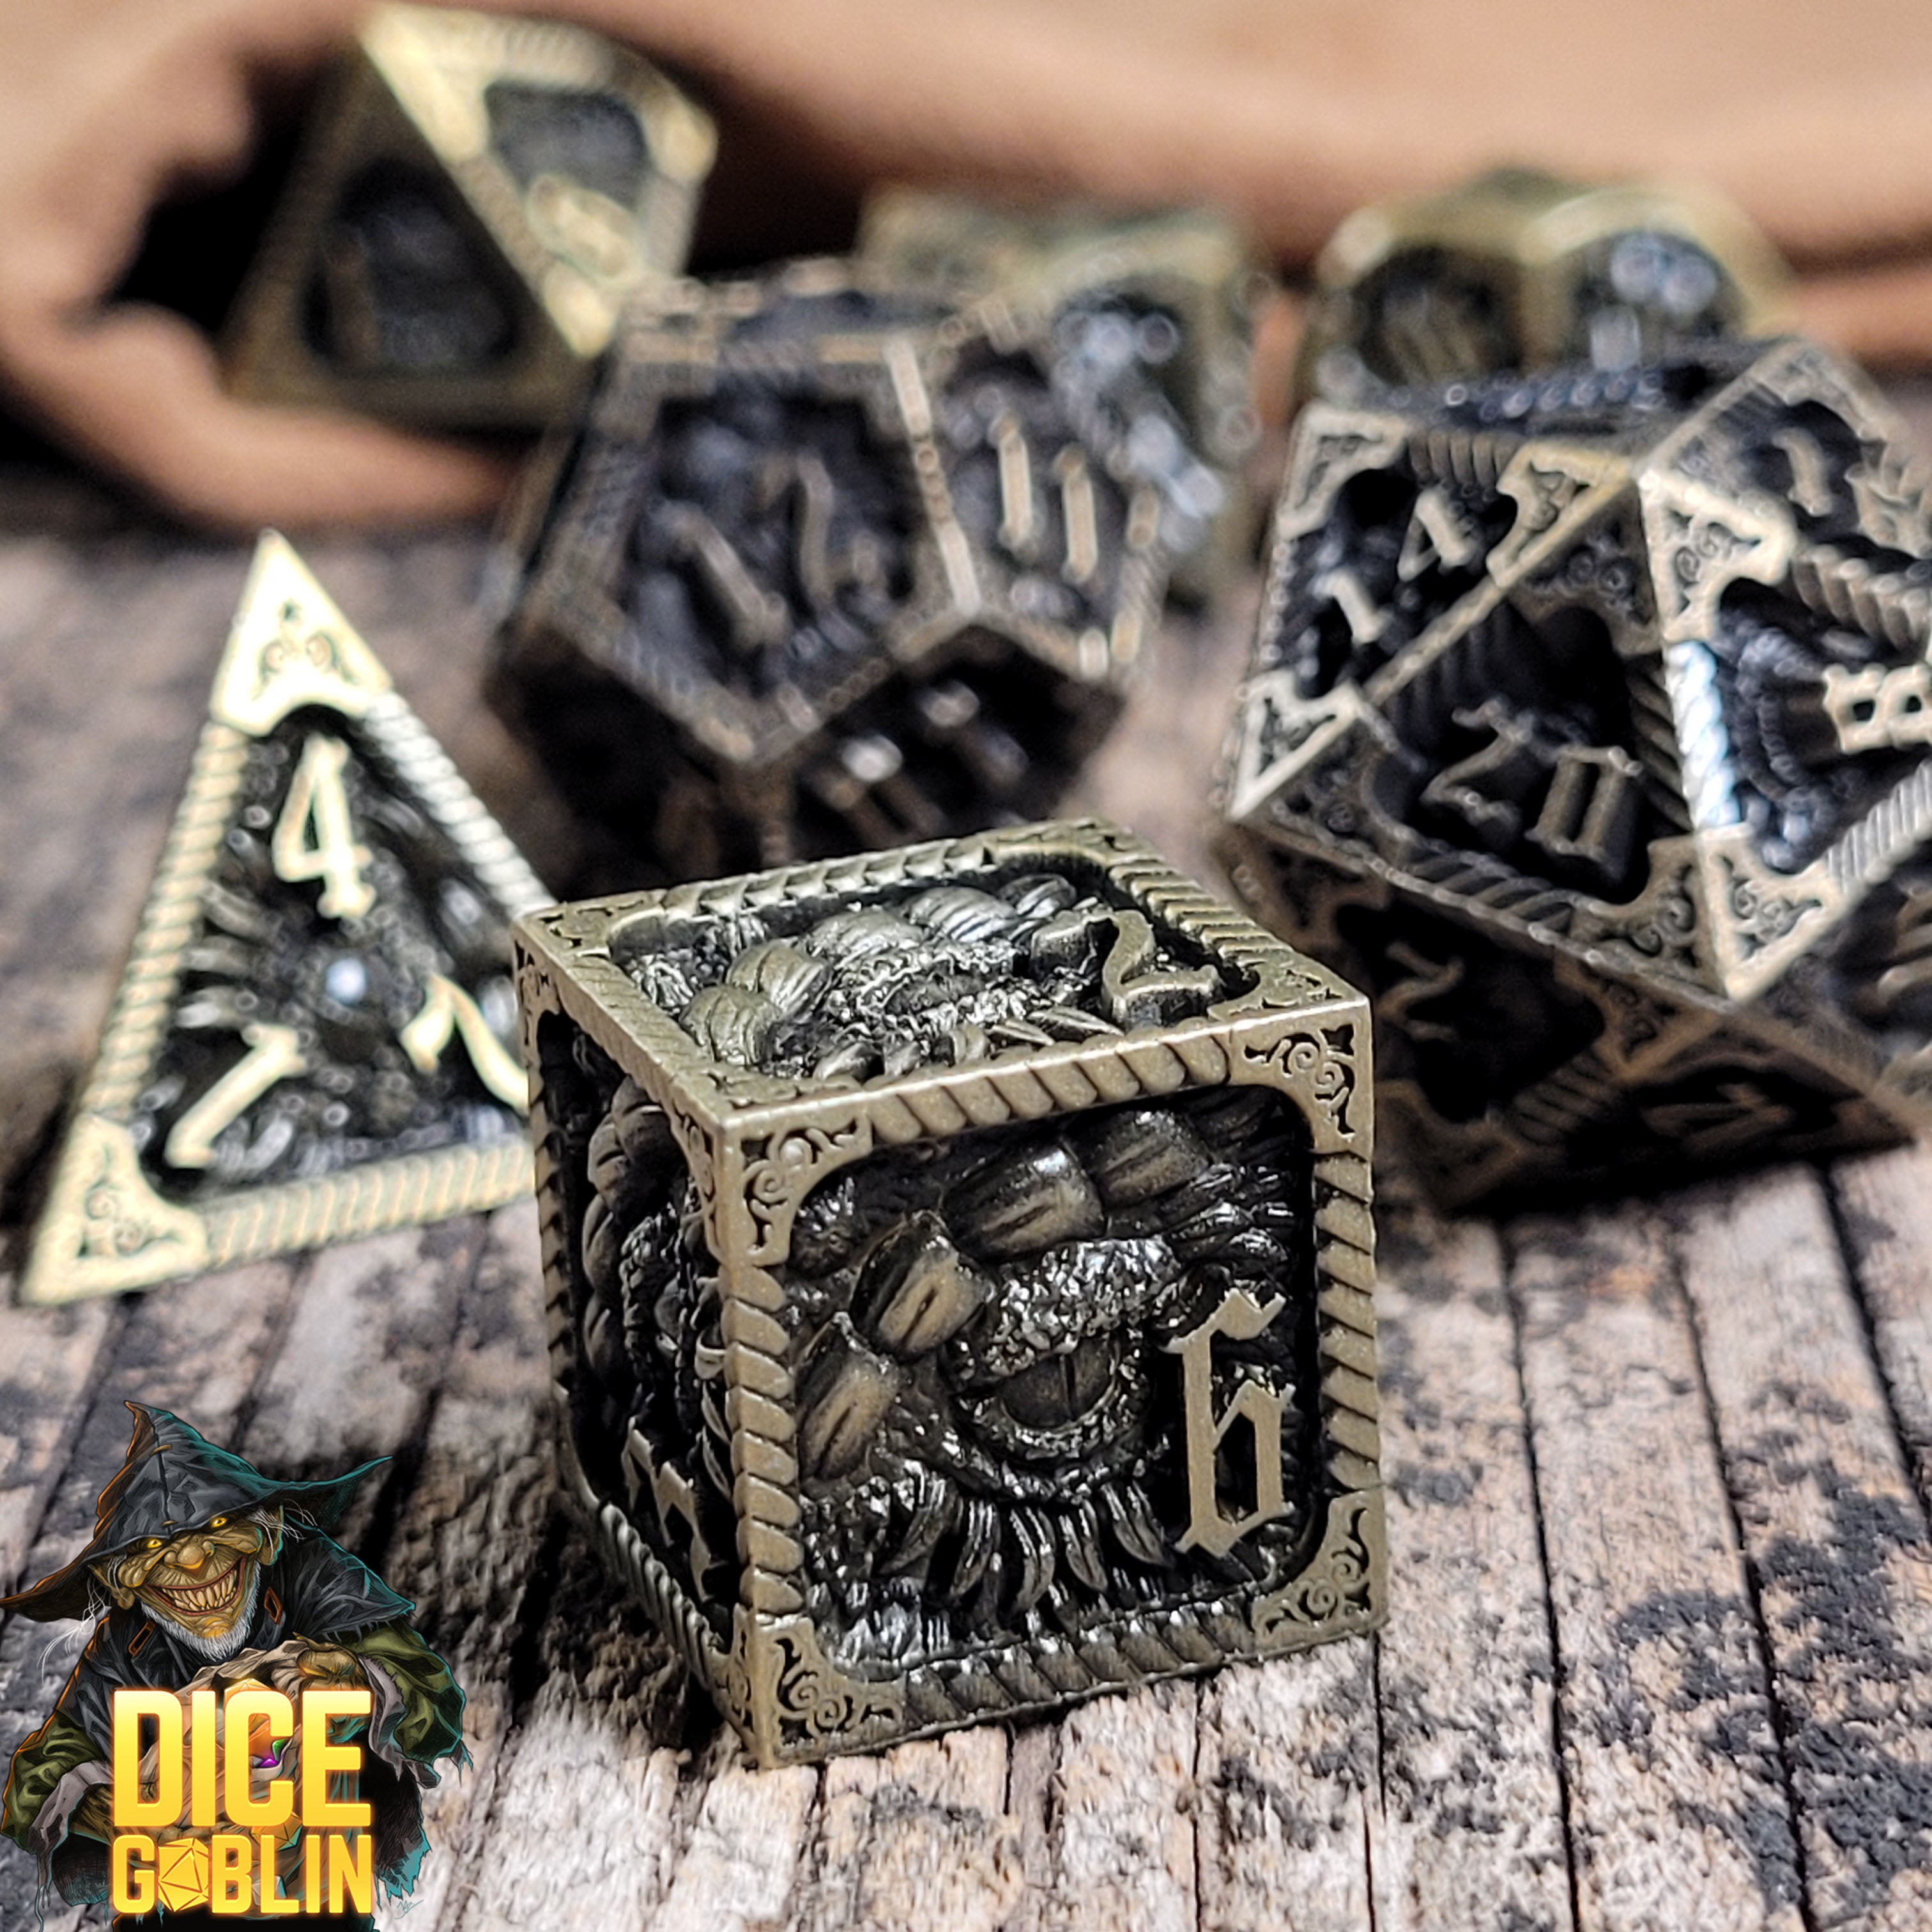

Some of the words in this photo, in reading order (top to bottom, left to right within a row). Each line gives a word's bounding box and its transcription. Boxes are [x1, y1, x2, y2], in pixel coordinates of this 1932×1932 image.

[271, 735, 376, 918] 4
[1082, 908, 1222, 998] 2
[1160, 1287, 1297, 1558] 6
